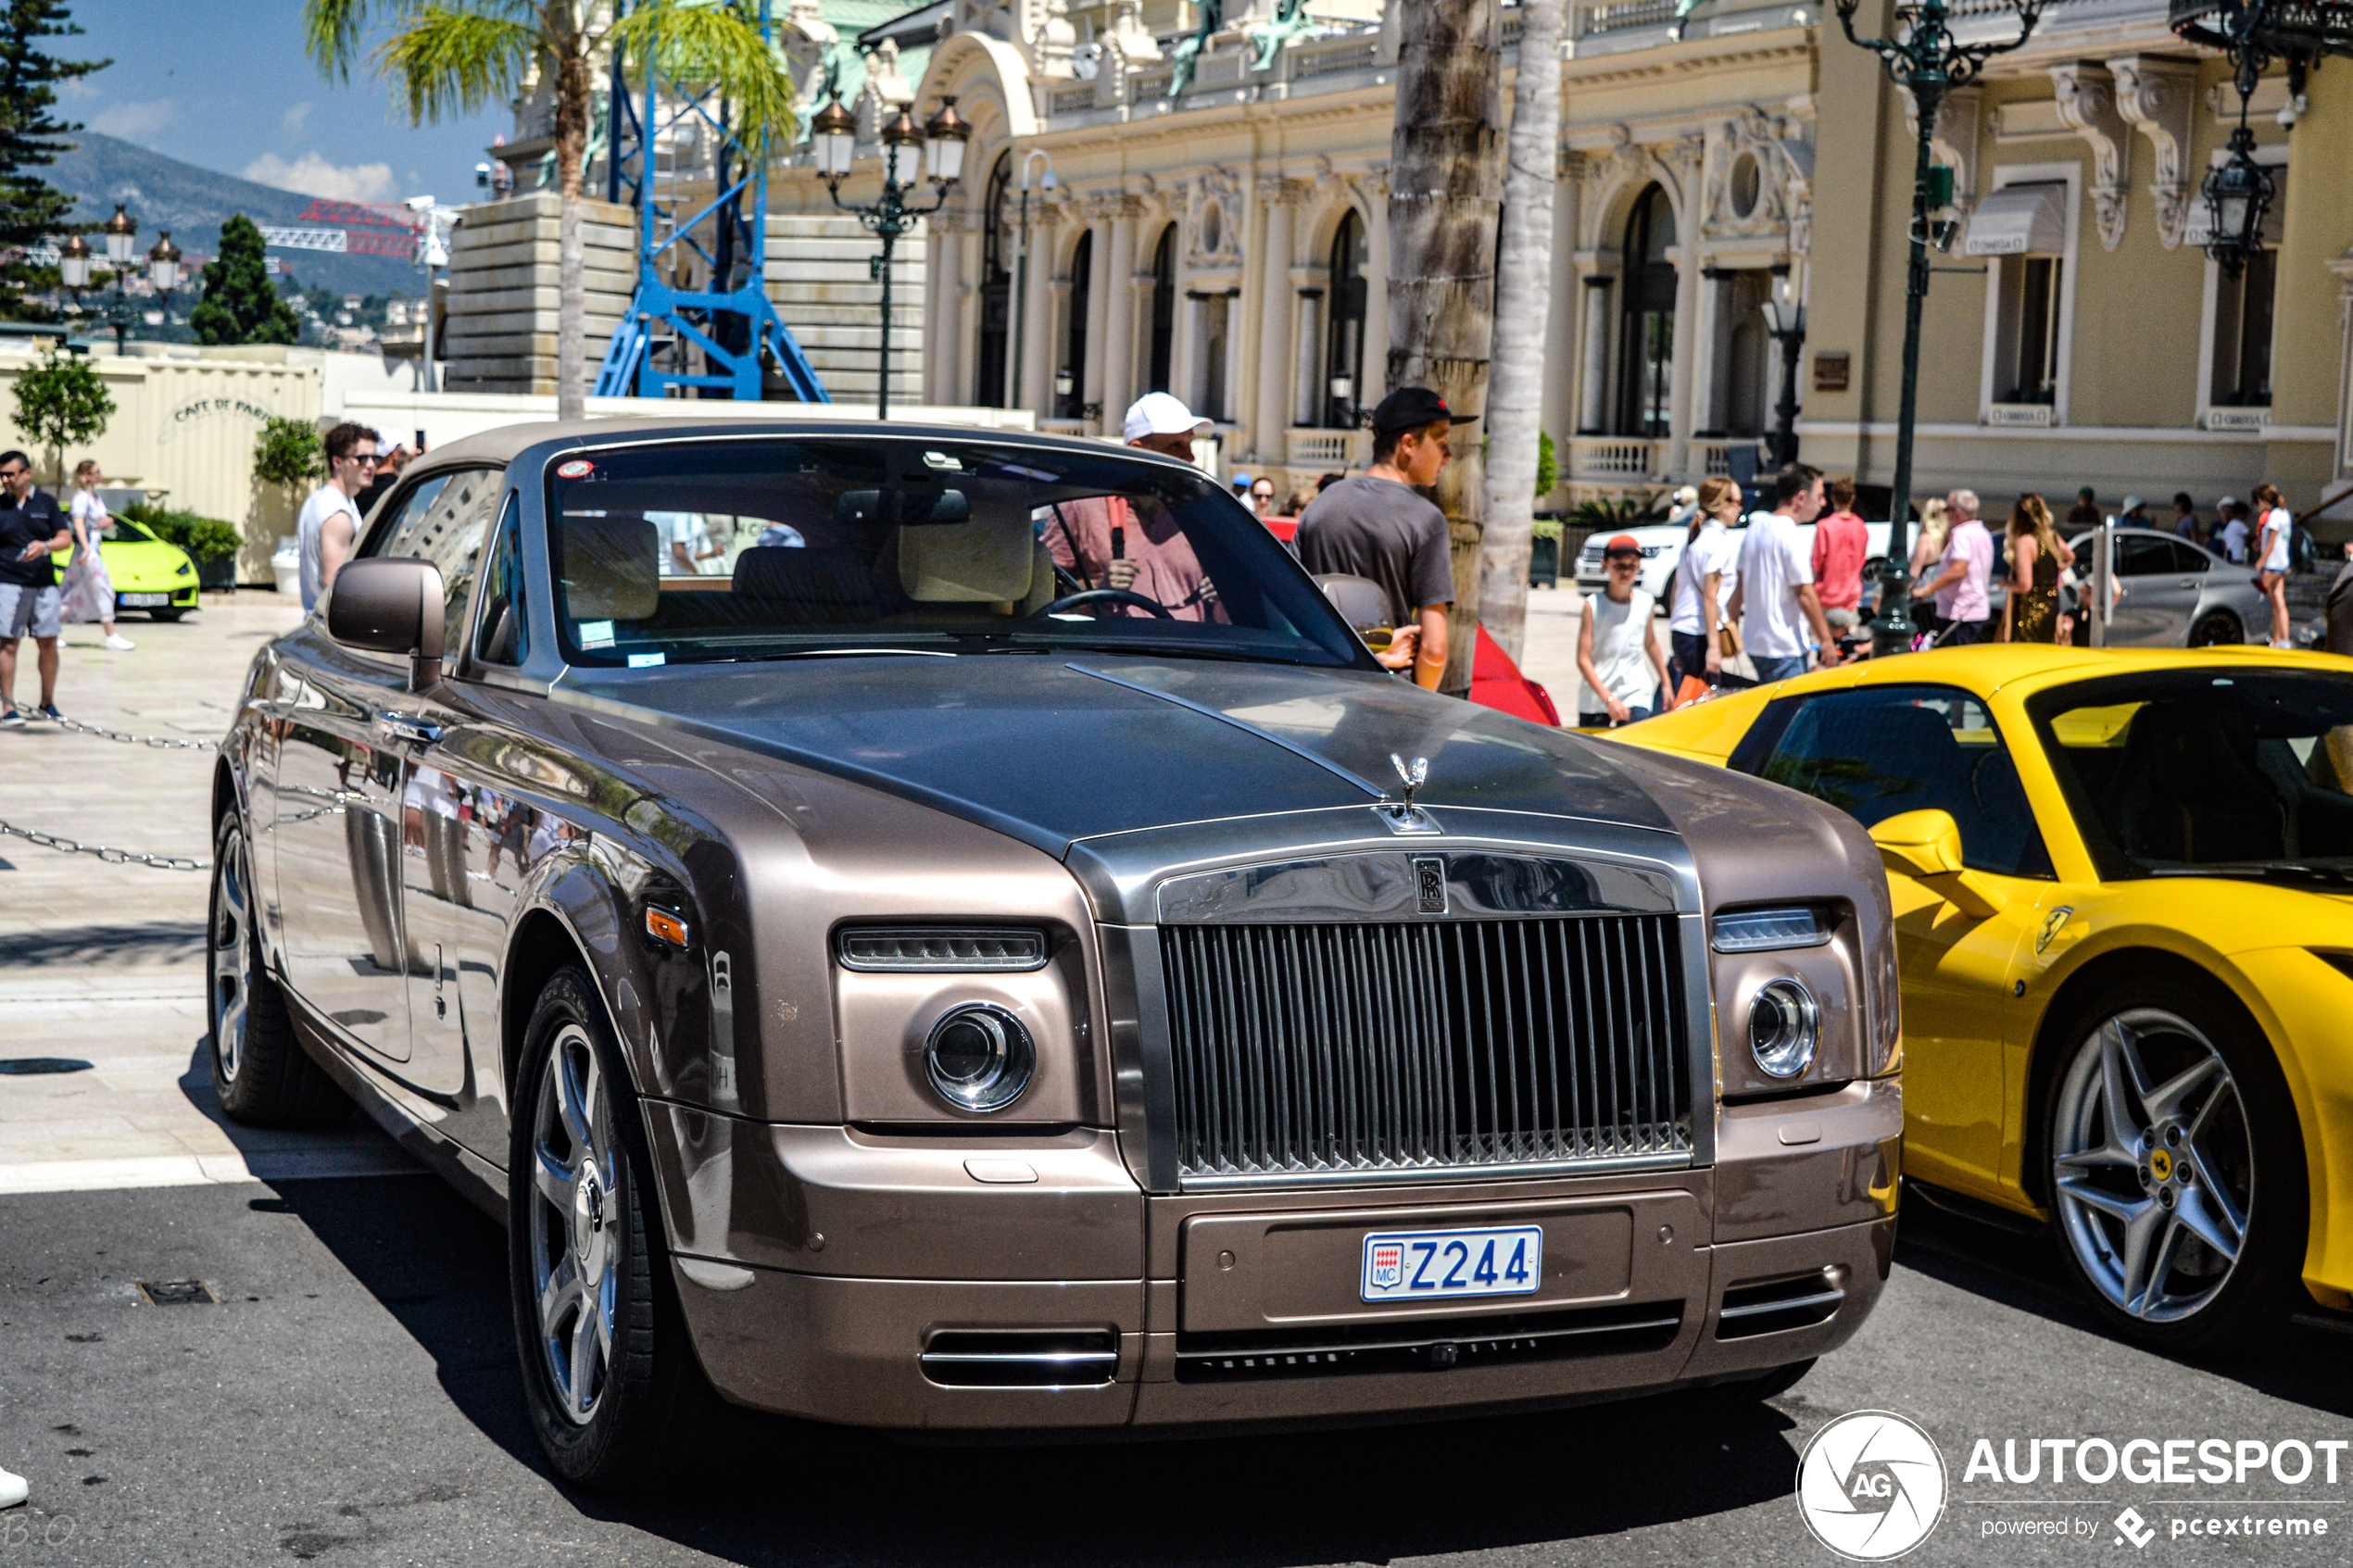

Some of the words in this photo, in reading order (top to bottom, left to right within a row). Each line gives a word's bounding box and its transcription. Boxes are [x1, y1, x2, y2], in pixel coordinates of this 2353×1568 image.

[235, 400, 272, 421] PARI
[1376, 1268, 1396, 1282] MC
[1410, 1237, 1529, 1289] Z244
